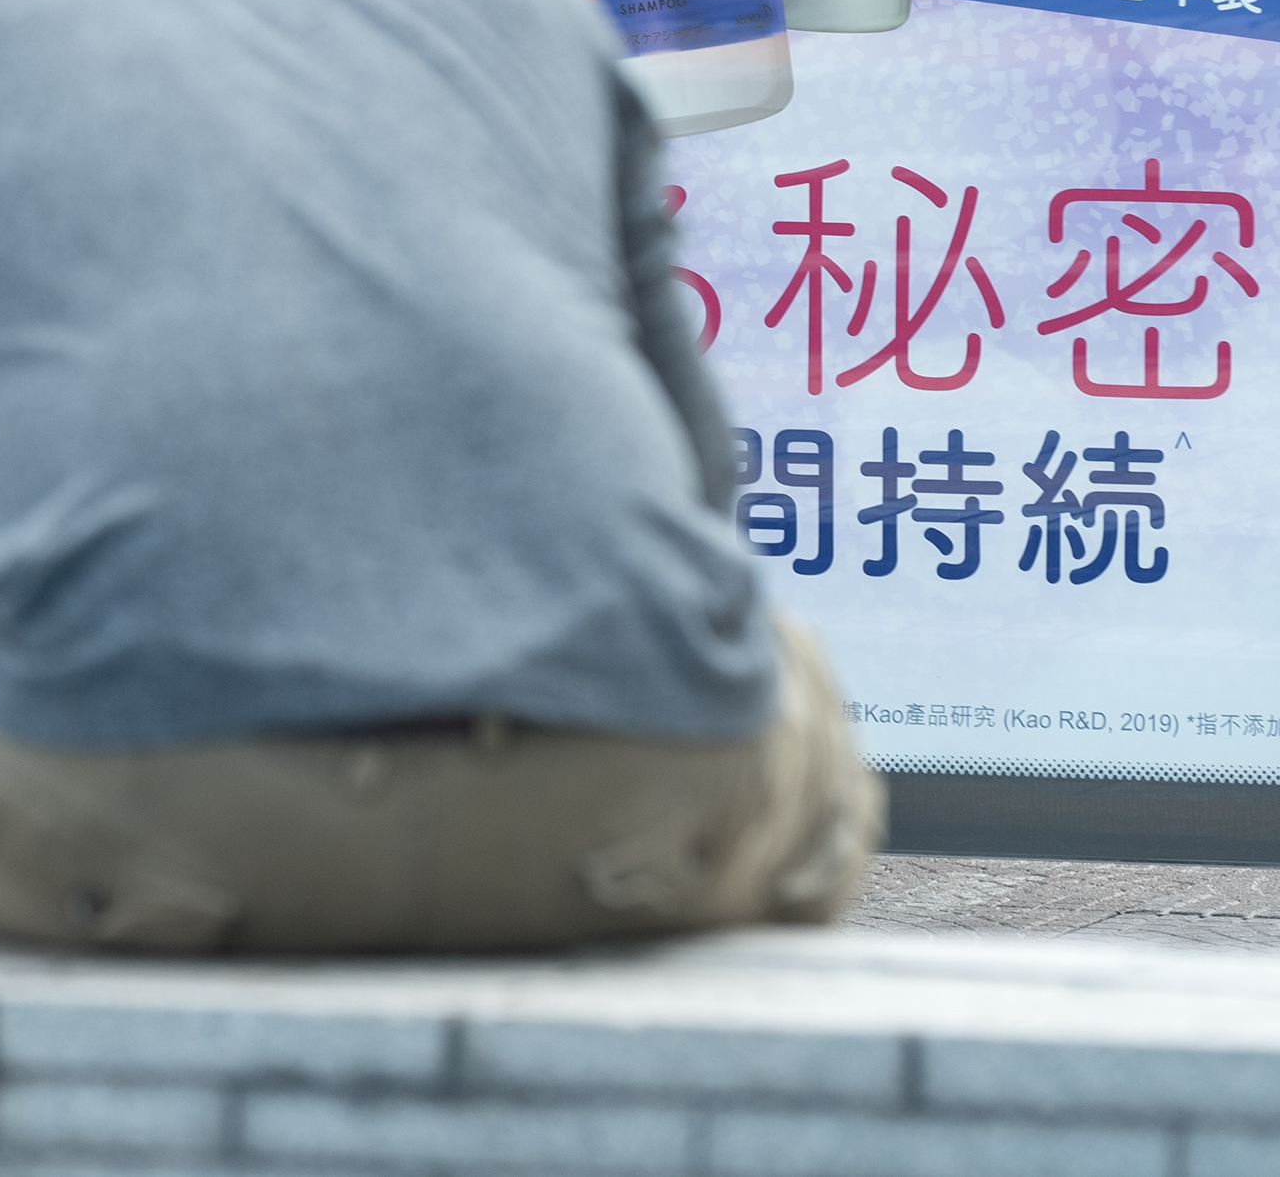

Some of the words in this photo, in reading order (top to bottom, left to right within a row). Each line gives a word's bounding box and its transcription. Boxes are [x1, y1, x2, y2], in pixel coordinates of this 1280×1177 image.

[1003, 708, 1052, 732] (Kao
[1059, 710, 1113, 734] R&D,
[1120, 712, 1179, 738] 2019)
